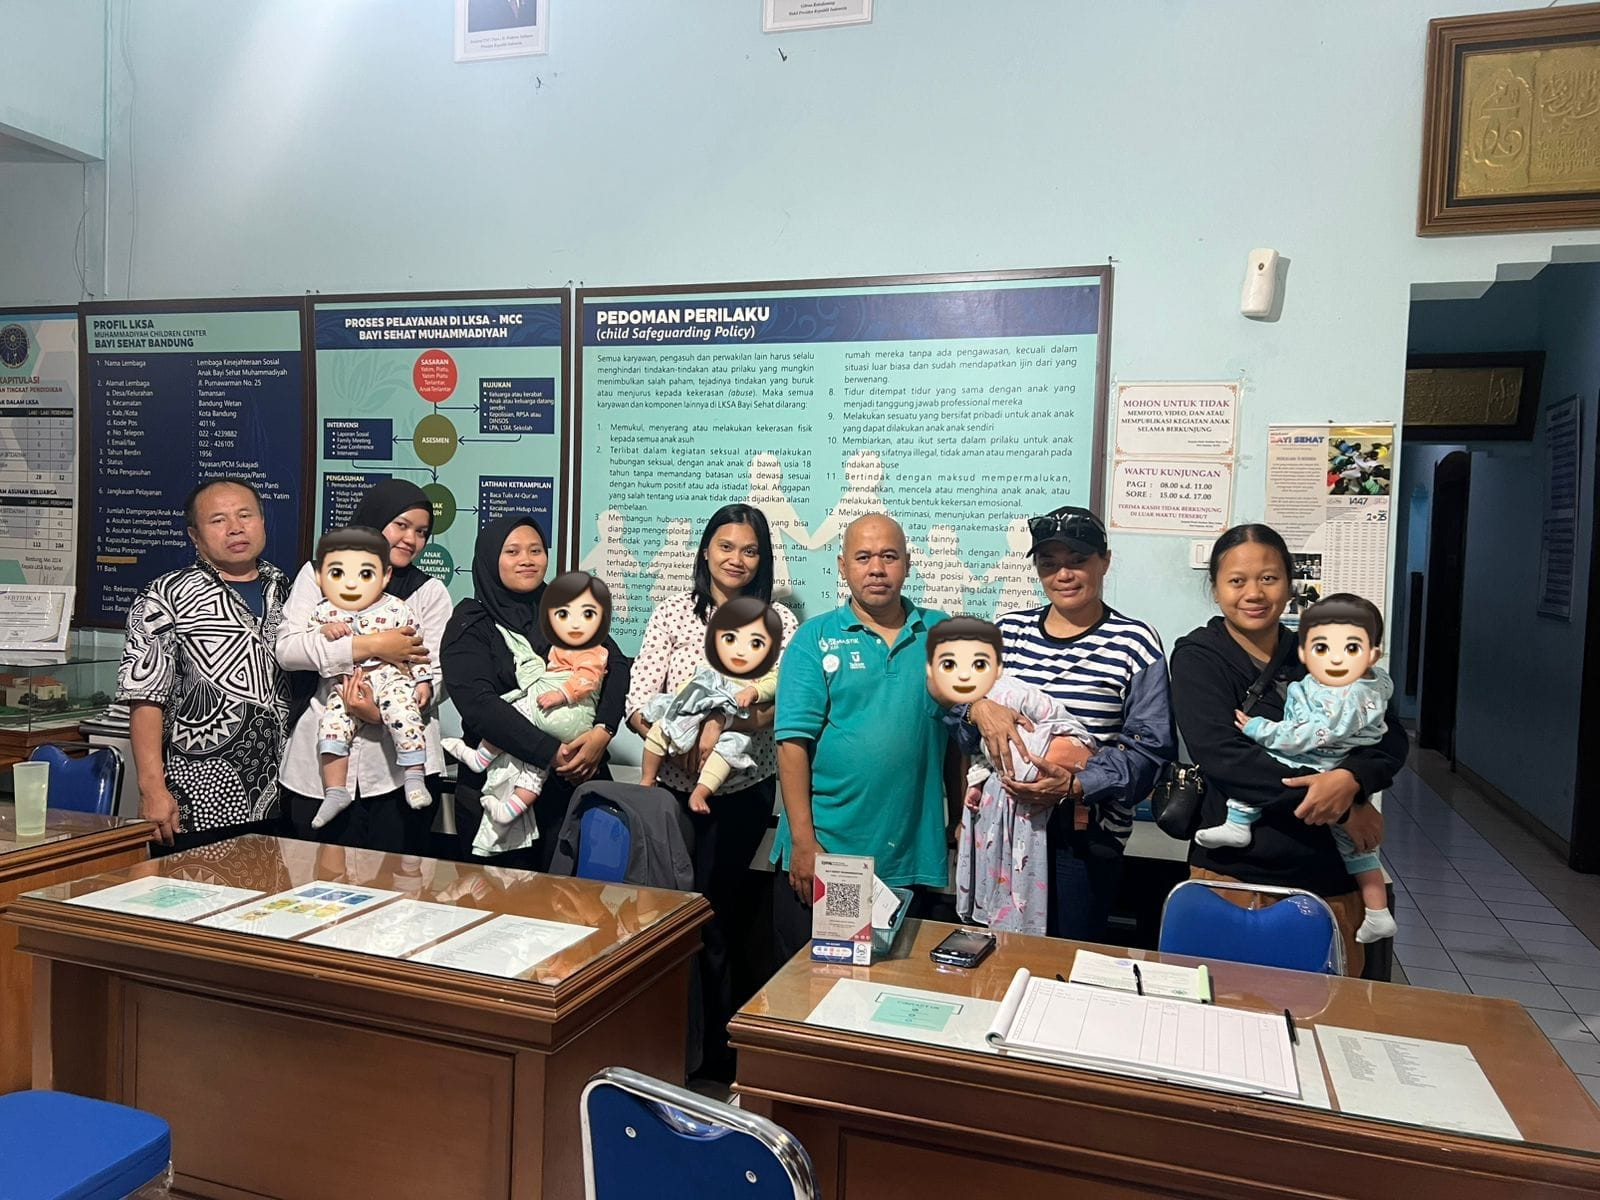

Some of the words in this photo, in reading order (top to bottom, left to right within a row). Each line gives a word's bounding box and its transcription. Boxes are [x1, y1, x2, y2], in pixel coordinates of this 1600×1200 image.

[597, 309, 680, 324] PEDOMAN
[684, 306, 769, 322] PERILAKU
[93, 320, 127, 329] PROFIL
[129, 319, 154, 328] LKSA
[344, 317, 384, 327] PROSES
[385, 316, 447, 326] PELAYANAN
[449, 315, 460, 325] DI
[461, 315, 490, 324] LKSA
[498, 314, 522, 324] MCC
[358, 330, 382, 339] BAYI
[383, 329, 416, 339] SEHAT
[417, 327, 507, 338] MUHAMMADIYAH
[596, 327, 629, 340] (child
[631, 326, 710, 341] Safeguarding
[714, 325, 754, 339] Policy)
[94, 339, 115, 347] BAYI
[116, 339, 146, 347] SEHAT
[147, 338, 194, 347] BANDUNG
[622, 354, 658, 362] karyawan,
[658, 354, 694, 363] pengasuh
[712, 353, 752, 361] perwakilan
[421, 359, 448, 367] SASARAN
[597, 366, 641, 375] menghindari
[730, 365, 755, 373] prilaku
[780, 364, 814, 373] mungkin
[668, 377, 694, 386] paham,
[698, 377, 731, 386] tejadinya
[868, 387, 906, 395] ditempat
[935, 388, 956, 396] yang
[988, 385, 1021, 394] dengan
[1053, 385, 1075, 393] yang
[198, 400, 222, 408] Bandung
[212, 410, 236, 418] Bandung
[326, 475, 364, 483] PENGASUHAN
[956, 486, 997, 495] menghina
[977, 498, 1022, 506] emosional.
[423, 552, 440, 560] ANAK
[420, 558, 443, 567] MAMPU
